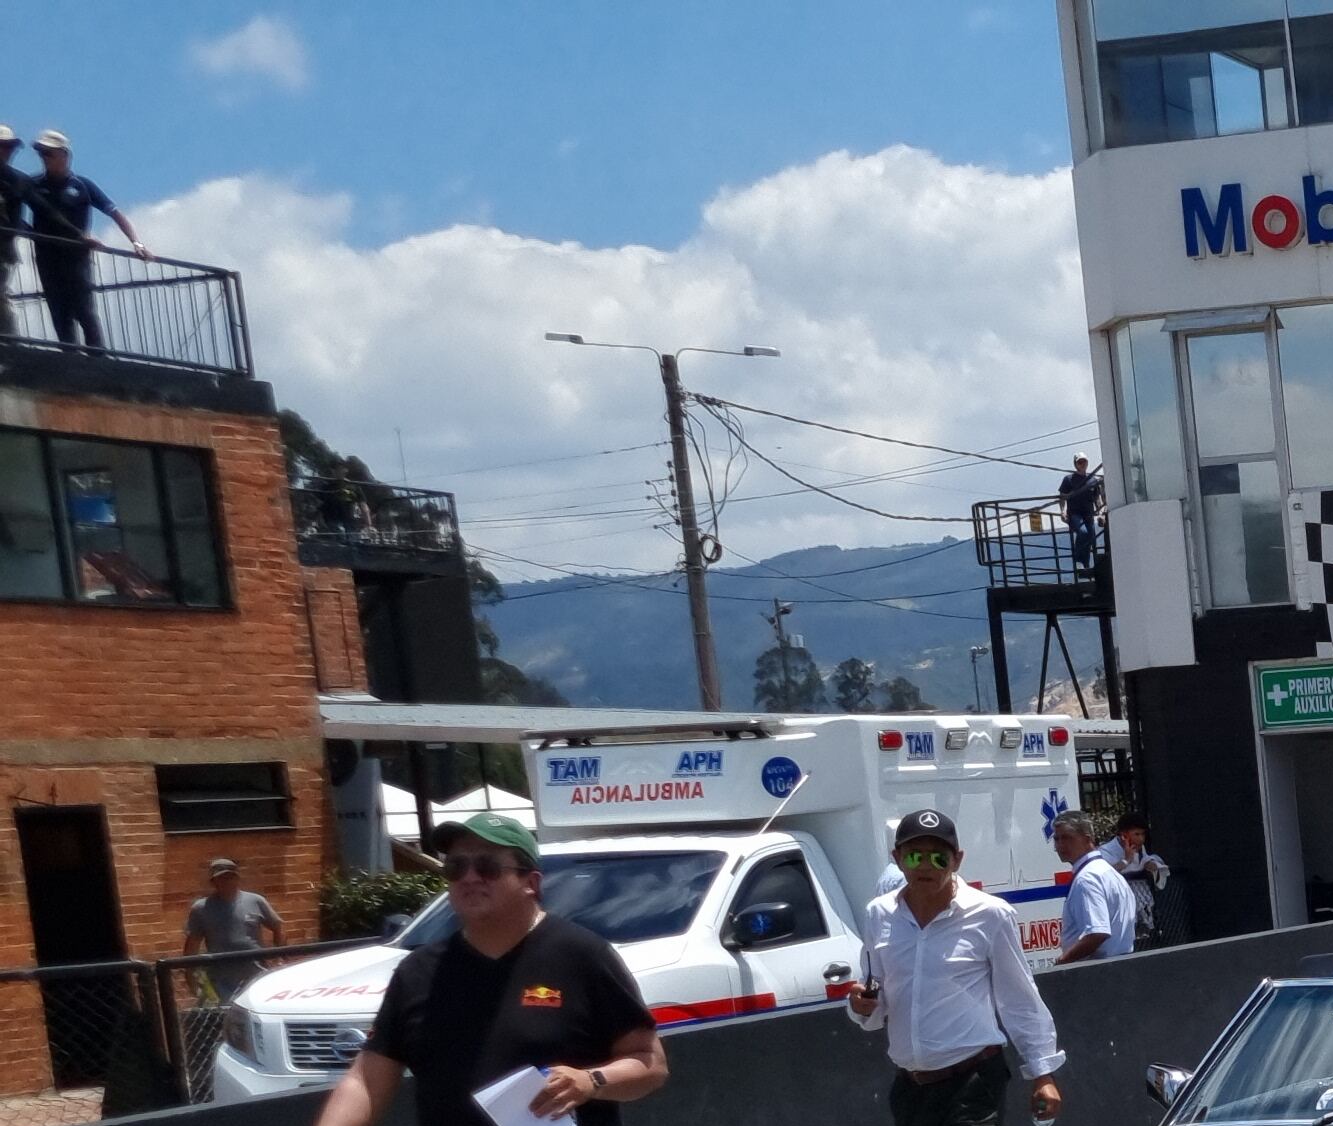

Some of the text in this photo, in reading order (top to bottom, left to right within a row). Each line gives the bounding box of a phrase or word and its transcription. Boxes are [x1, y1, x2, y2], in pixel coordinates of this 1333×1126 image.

[906, 732, 934, 755] TAM
[1023, 733, 1045, 754] APH
[548, 757, 600, 780] TAM
[677, 750, 723, 772] APH
